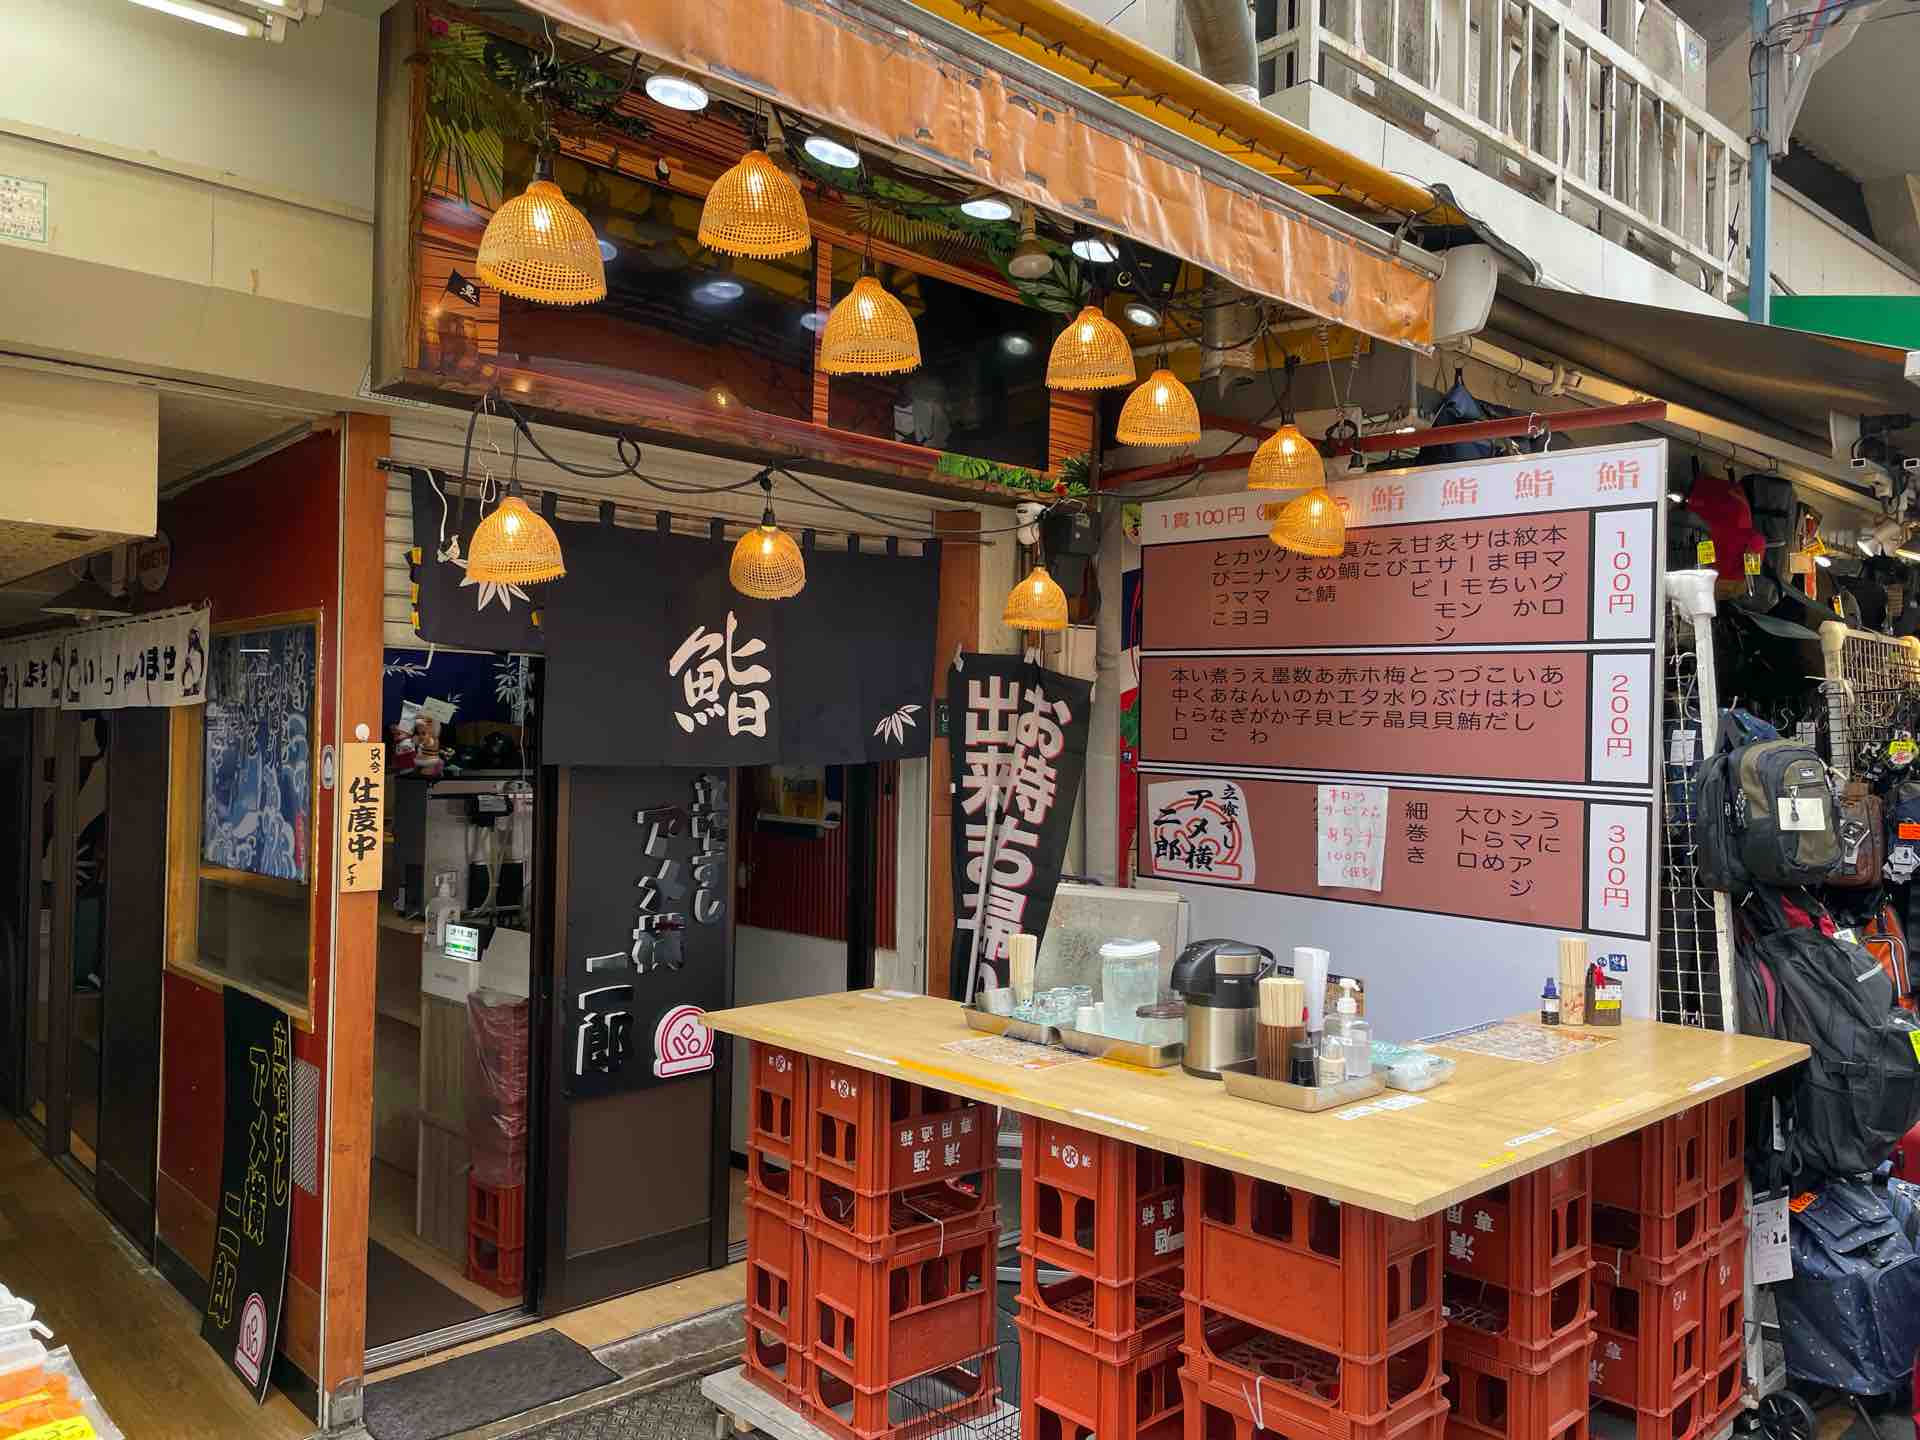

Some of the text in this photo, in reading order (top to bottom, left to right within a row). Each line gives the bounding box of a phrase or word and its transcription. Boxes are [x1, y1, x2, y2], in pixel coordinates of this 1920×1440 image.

[1160, 506, 1246, 529] 1貫100円
[1371, 486, 1405, 513] 鮨
[1441, 478, 1479, 505] 鮨
[1515, 470, 1554, 498] 鮨
[1598, 460, 1640, 492] 鮨
[1212, 551, 1230, 626] とびっこ
[1231, 551, 1250, 626] カニマヨ
[1252, 549, 1272, 625] ツナマヨ
[1316, 552, 1337, 603] め鯖
[1338, 541, 1361, 580] 真鯛
[1363, 538, 1383, 578] たこ
[1386, 537, 1409, 577] えび
[1410, 536, 1433, 598] 甘エビ
[1435, 533, 1458, 642] 炙サーモン
[1461, 532, 1485, 619] サーモン
[1487, 530, 1511, 596] はまち
[1513, 527, 1538, 617] 紋甲いか
[1541, 524, 1568, 616] 本マグロ
[1609, 530, 1635, 614] 100円
[668, 609, 772, 738] 鮨
[1170, 666, 1190, 742] 本中トロ
[1190, 668, 1208, 724] いくら
[1208, 666, 1228, 743] 煮あなご
[1230, 667, 1249, 725] うなぎ
[1249, 667, 1269, 745] えんがわ
[1271, 666, 1291, 725] 墨いか
[1292, 666, 1313, 726] 数の子
[1314, 666, 1336, 727] あか貝
[1337, 666, 1360, 728] 赤エビ
[1359, 666, 1381, 728] ホタテ
[1383, 665, 1406, 729] 梅水晶
[1407, 666, 1430, 730] とり貝
[1432, 667, 1458, 730] つぶ貝
[1456, 665, 1484, 731] づけ鮪
[1486, 666, 1509, 731] こはだ
[1511, 666, 1536, 732] いわし
[1540, 665, 1564, 709] あじ
[1606, 673, 1633, 758] 200円
[347, 775, 380, 862] 仕度中
[1153, 807, 1182, 861] 二郎
[1185, 789, 1214, 872] アメ横
[1220, 783, 1240, 849] 立喰すし
[1404, 800, 1428, 864] 細巻き
[1455, 804, 1480, 870] 大トロ
[1482, 807, 1507, 872] ひらめ
[1536, 810, 1561, 854] うに
[1509, 808, 1536, 897] シマアジ
[1603, 824, 1630, 908] 300円
